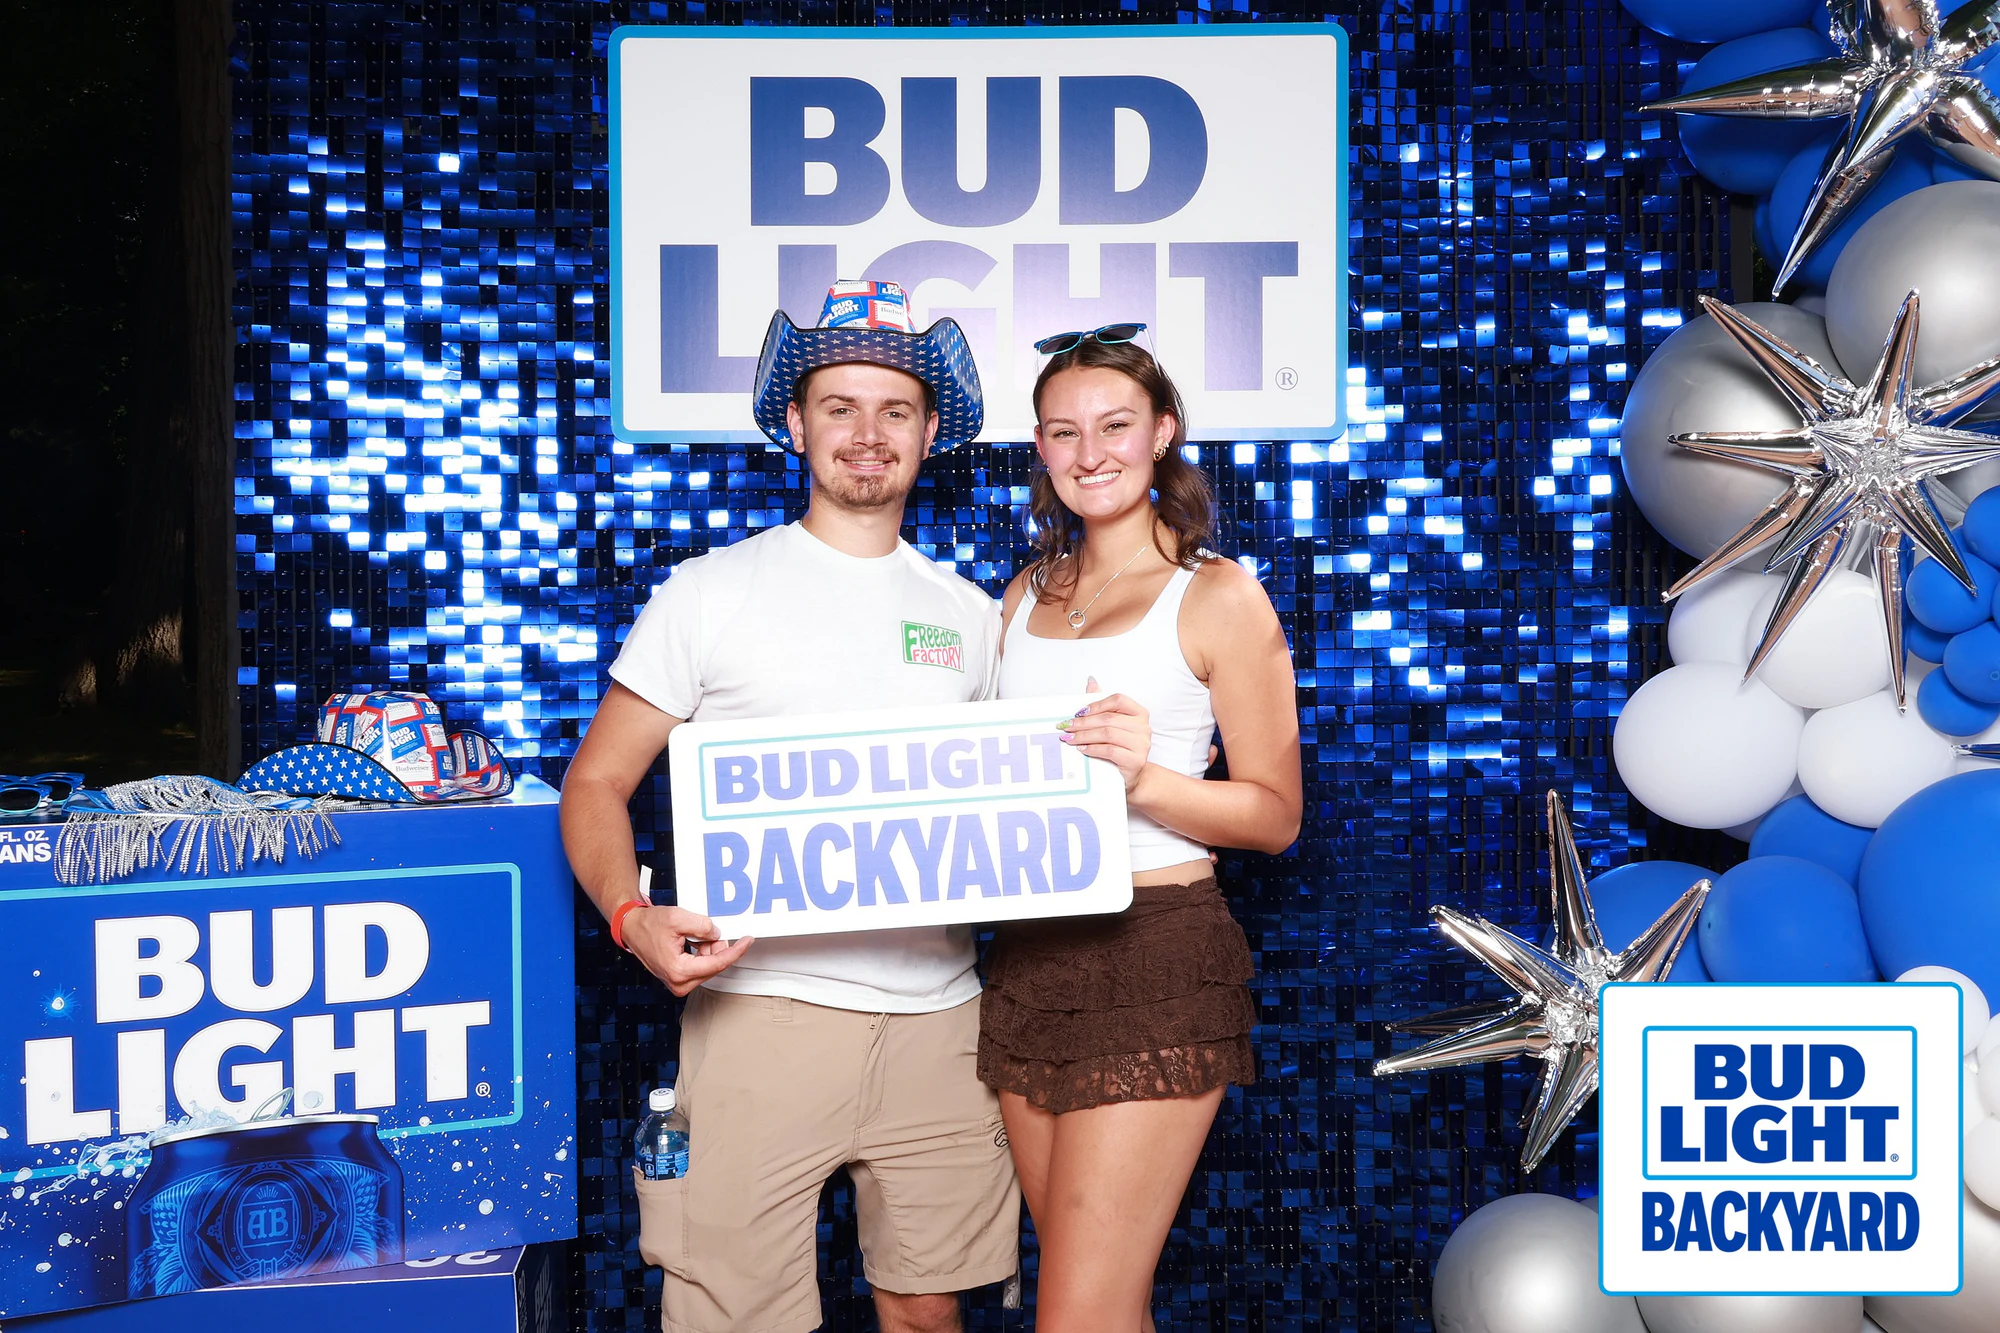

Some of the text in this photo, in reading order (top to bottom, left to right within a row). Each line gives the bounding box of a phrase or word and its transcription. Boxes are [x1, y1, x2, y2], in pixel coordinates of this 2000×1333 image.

[750, 75, 1208, 228] BUD
[831, 299, 853, 313] BUD
[390, 726, 410, 741] BUD
[395, 764, 430, 772] Budweiser
[714, 732, 1068, 805] BUD LIGHT
[24, 830, 49, 842] OZ.
[703, 806, 1101, 917] BACKYARD
[95, 901, 430, 1024] BUD
[25, 1000, 490, 1146] LIGHT
